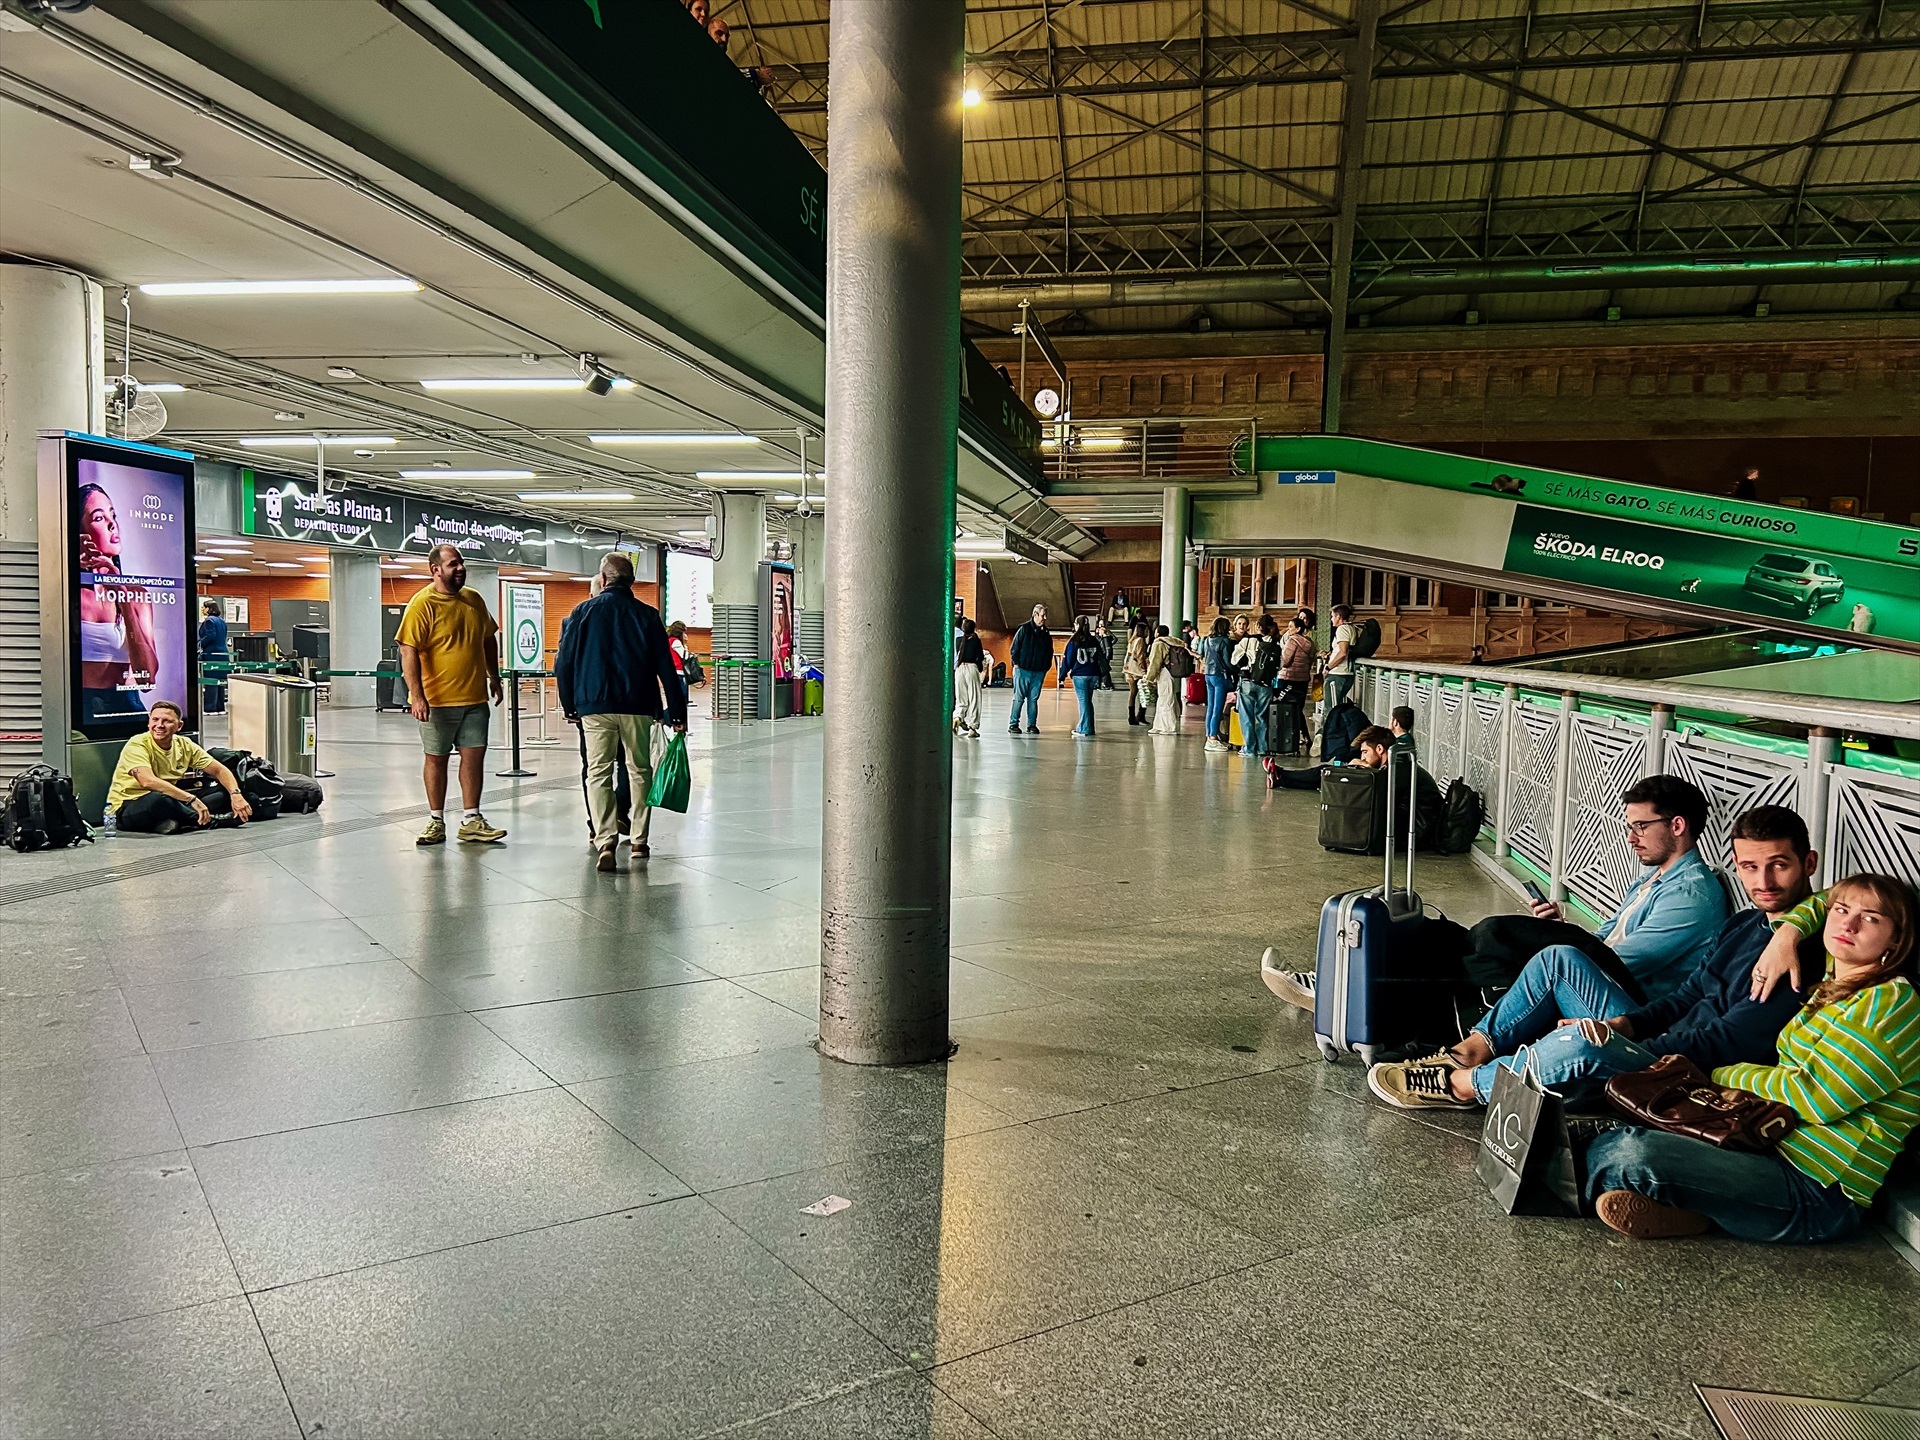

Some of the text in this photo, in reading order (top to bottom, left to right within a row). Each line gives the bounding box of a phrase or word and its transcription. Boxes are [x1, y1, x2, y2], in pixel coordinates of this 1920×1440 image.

[800, 186, 818, 235] SÉ
[1295, 473, 1319, 483] global
[129, 509, 175, 522] INMODE
[344, 499, 382, 522] Planta
[385, 506, 393, 524] 1
[1543, 482, 1799, 535] SÉ MÁS GATO. SÉ MÁS CURIOSO.
[141, 522, 163, 530] IBERIA
[294, 517, 339, 532] DEPARTURES
[340, 523, 360, 535] FLOOR
[434, 515, 524, 544] Control de equipajes
[1533, 533, 1665, 570] ŠKODA ELROQ
[94, 575, 102, 583] LA
[103, 575, 139, 585] REVOLUCIÓN
[140, 577, 162, 586] EMPEZÓ
[95, 590, 176, 605] MORPHEUS8
[1077, 647, 1097, 665] 07
[1486, 1102, 1522, 1150] AC
